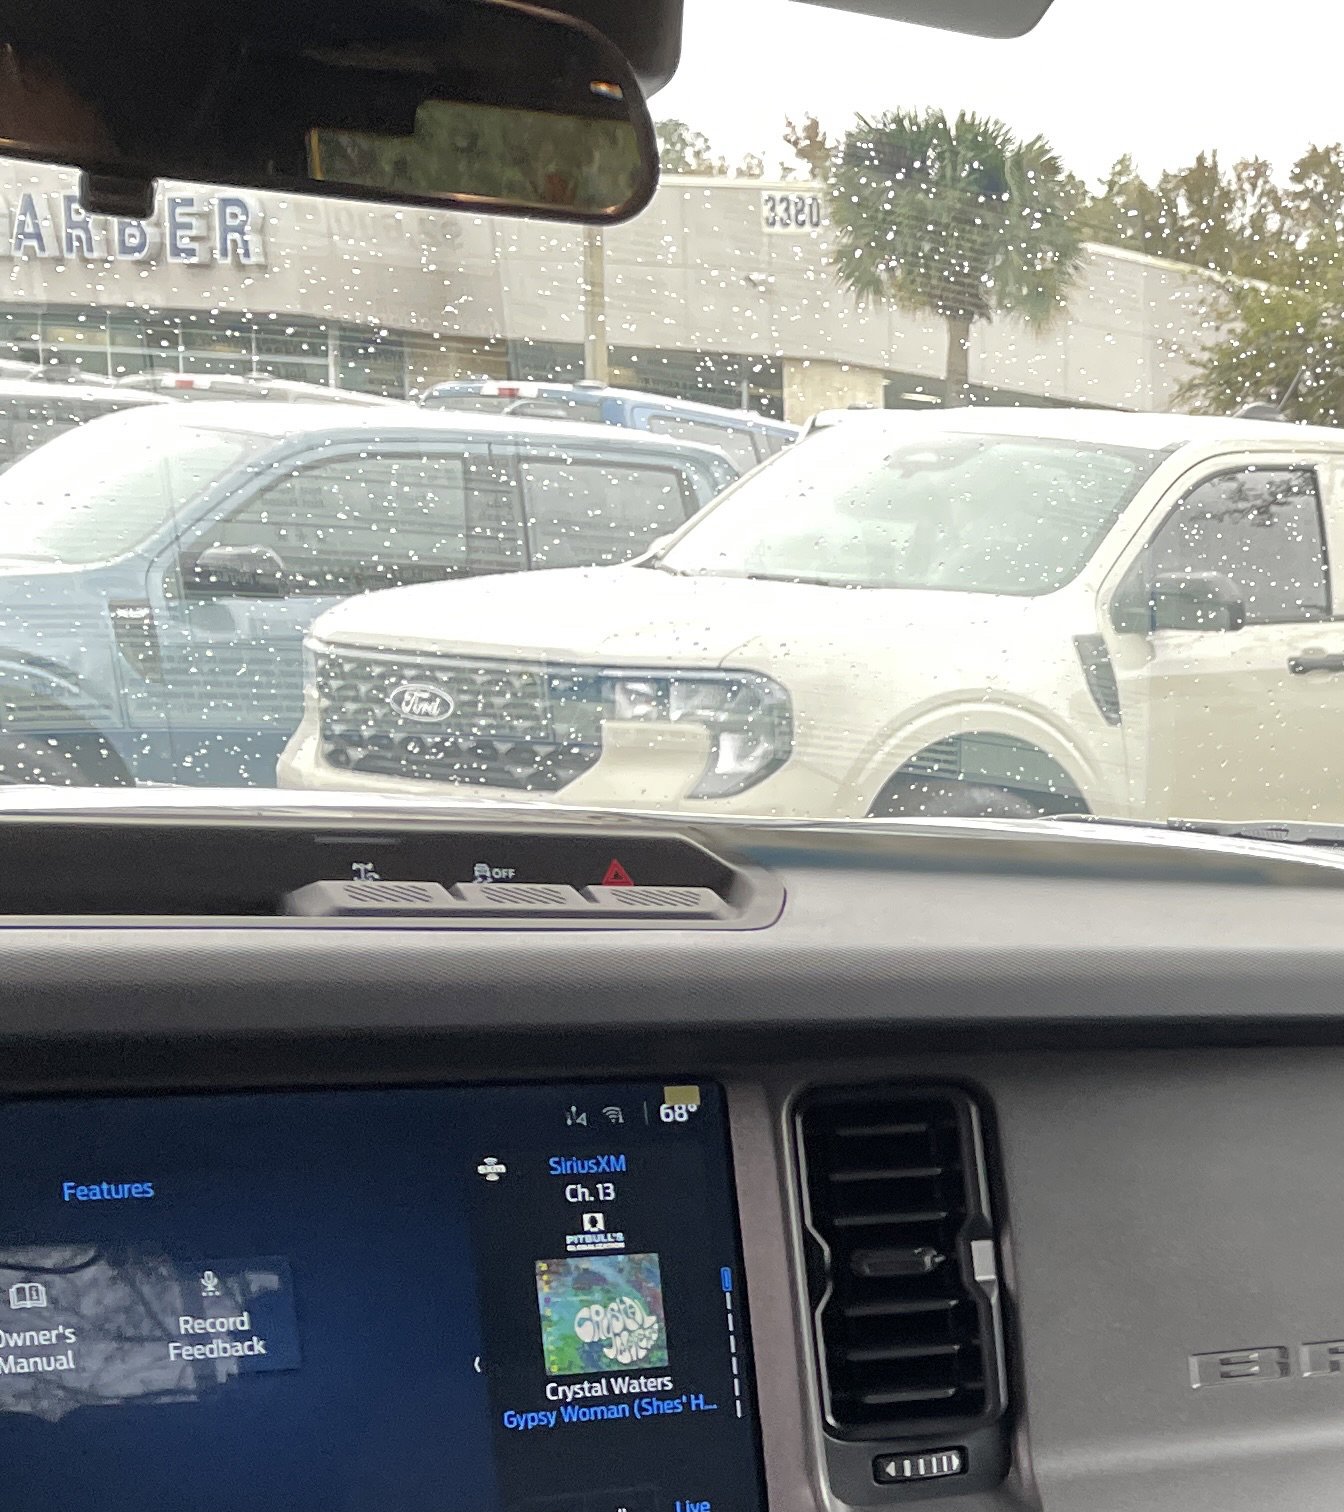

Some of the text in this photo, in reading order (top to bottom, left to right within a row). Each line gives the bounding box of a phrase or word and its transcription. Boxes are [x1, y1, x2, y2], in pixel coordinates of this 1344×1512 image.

[492, 867, 516, 881] OFF
[549, 1154, 627, 1175] SiriusXM
[63, 1181, 155, 1201] Features
[565, 1183, 616, 1202] Ch. 13
[179, 1312, 250, 1335] Record
[169, 1336, 267, 1361] Feedback
[0, 1350, 76, 1374] Manual
[545, 1375, 674, 1402] Crystal Waters
[503, 1410, 558, 1430] Gypsy
[560, 1402, 630, 1423] Woman
[634, 1395, 687, 1419] (Shes'
